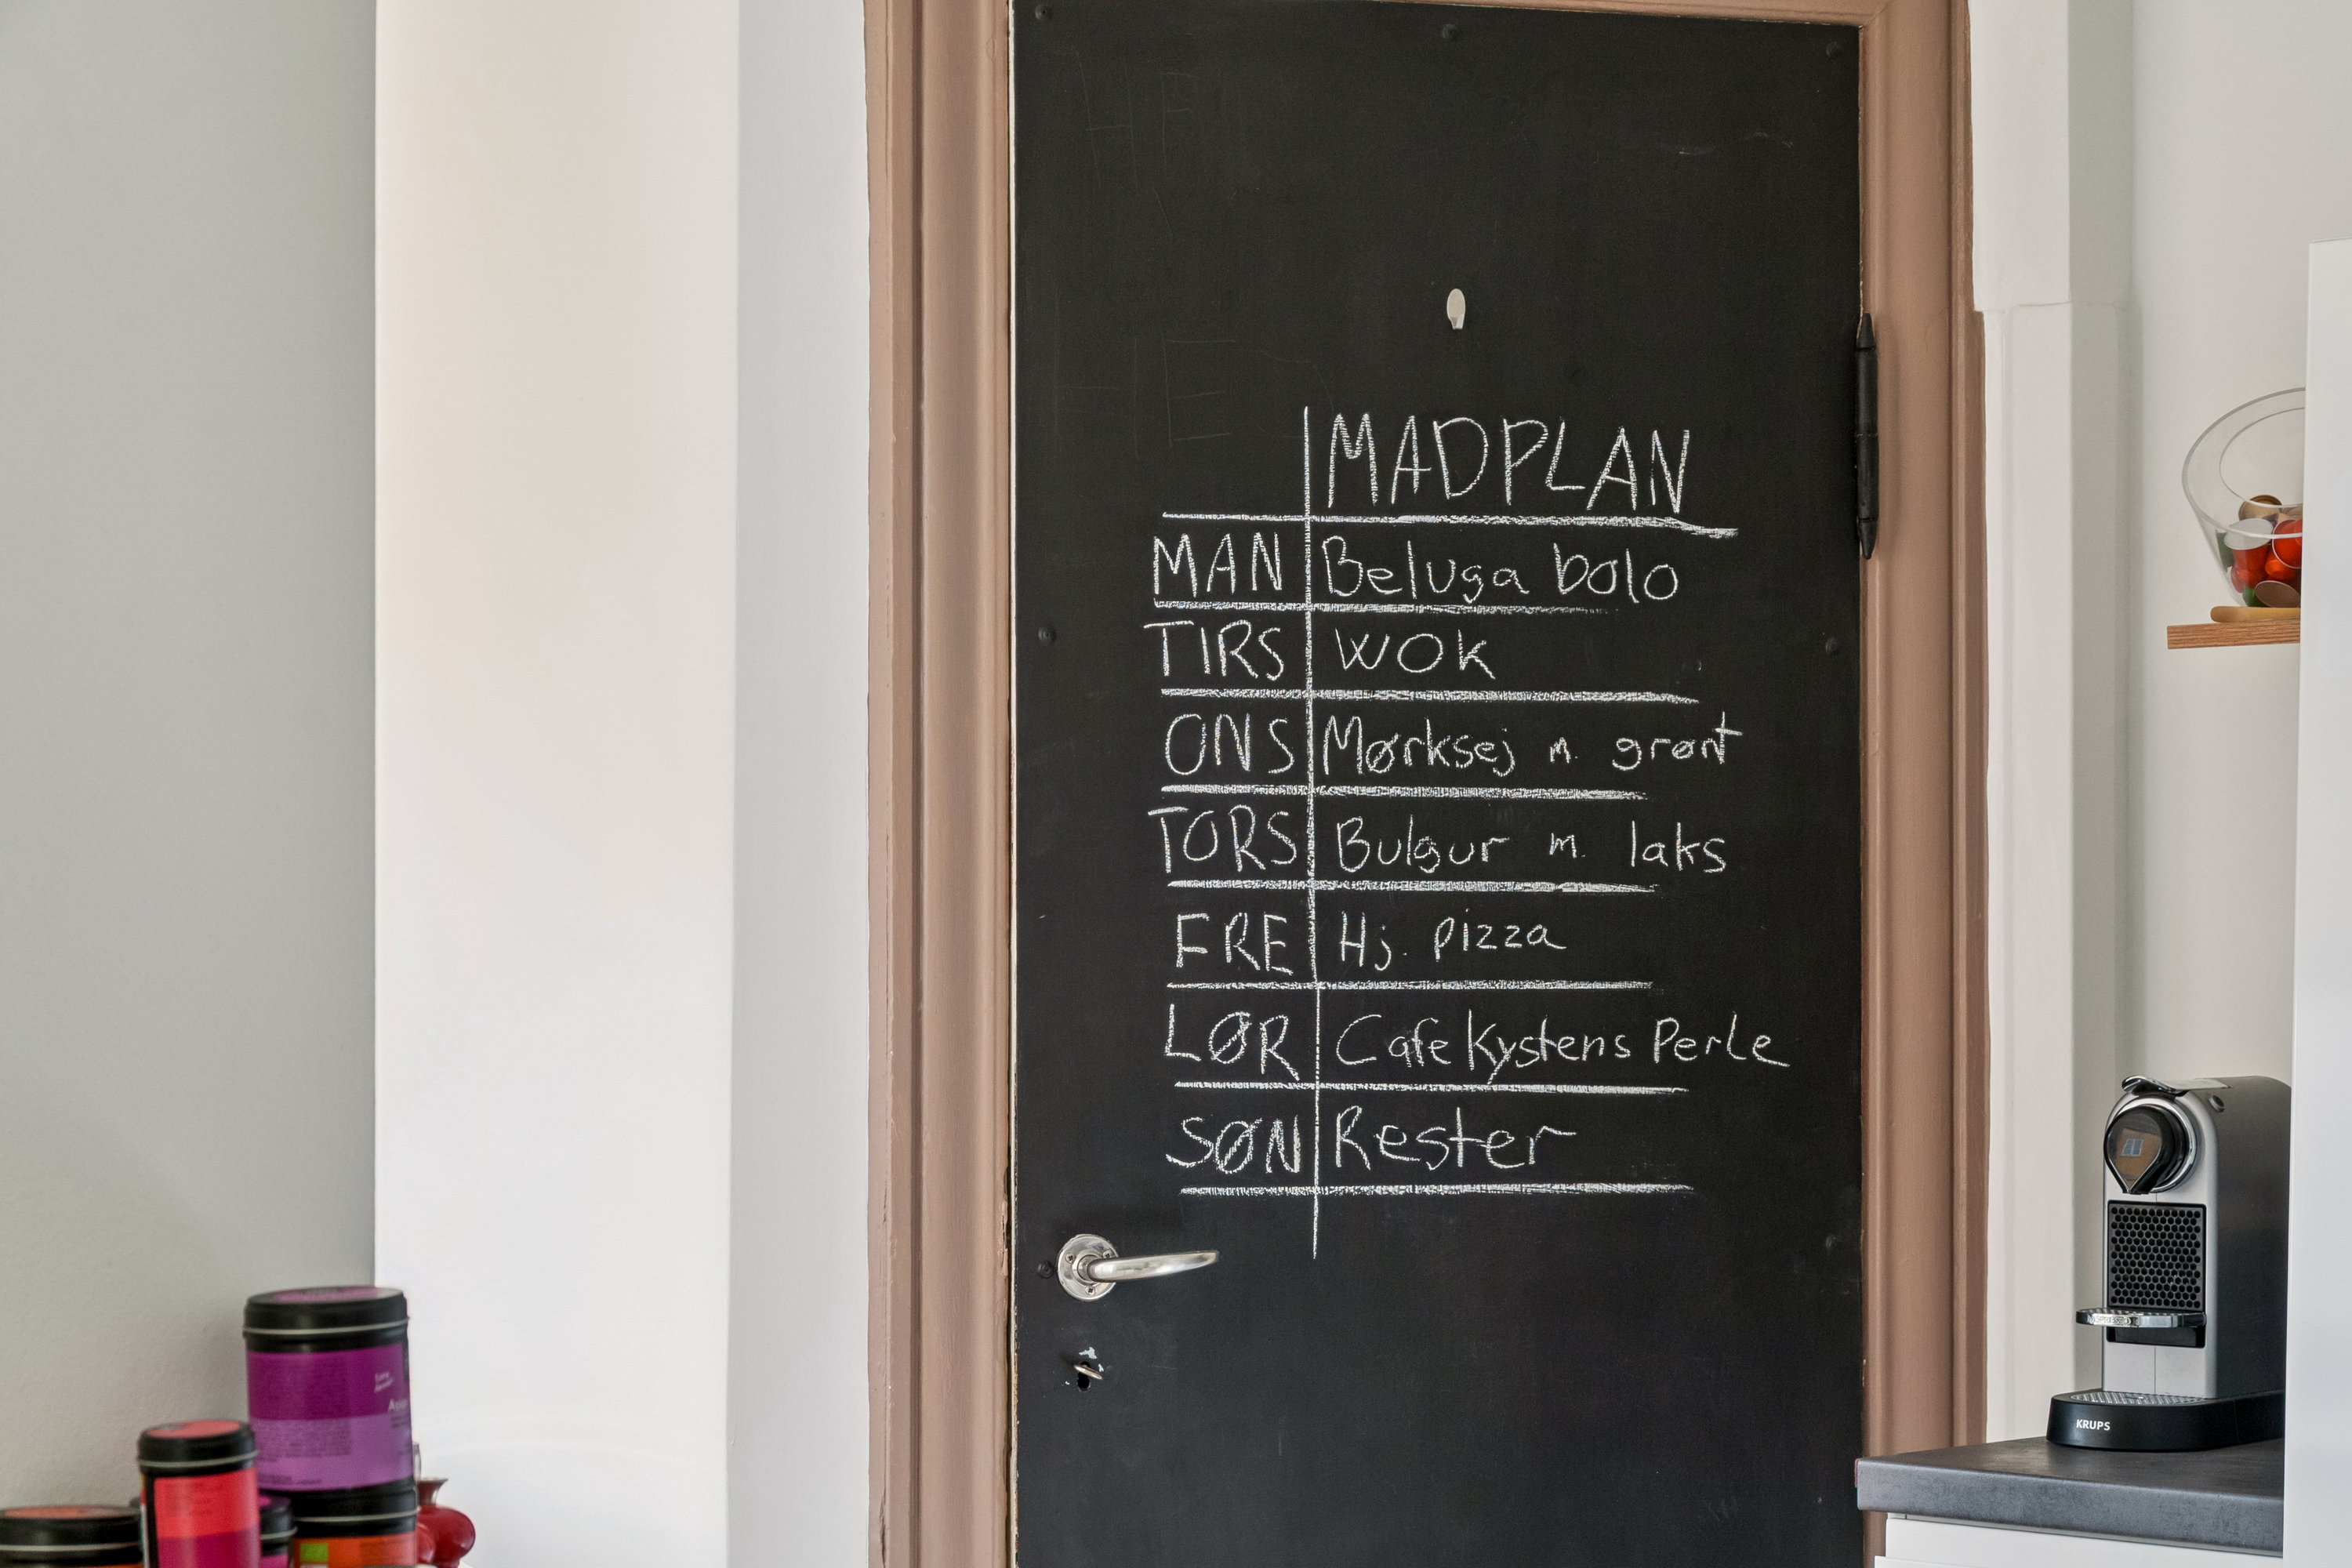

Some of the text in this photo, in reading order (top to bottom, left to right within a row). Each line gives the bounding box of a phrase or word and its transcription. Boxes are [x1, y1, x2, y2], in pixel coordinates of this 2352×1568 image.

[1328, 413, 1690, 513] MADPLAN
[1153, 532, 1282, 597] MAN
[1322, 535, 1679, 604] Beluga bolo
[1143, 619, 1284, 681] TIRS
[1165, 713, 1294, 775] ONS
[1323, 715, 1515, 777] Mørksej
[1613, 712, 1742, 771] grønt
[1148, 804, 1297, 873] TORS
[1337, 815, 1509, 873] Bulgur
[1632, 821, 1726, 873] laks
[1176, 913, 1294, 975] FRE
[1164, 1004, 1300, 1081] LØR
[1336, 1009, 1790, 1083] Cafe Kystens Perle
[1166, 1115, 1301, 1174] SØN
[1336, 1105, 1576, 1171] Rester
[2076, 1419, 2111, 1431] KRUPS
